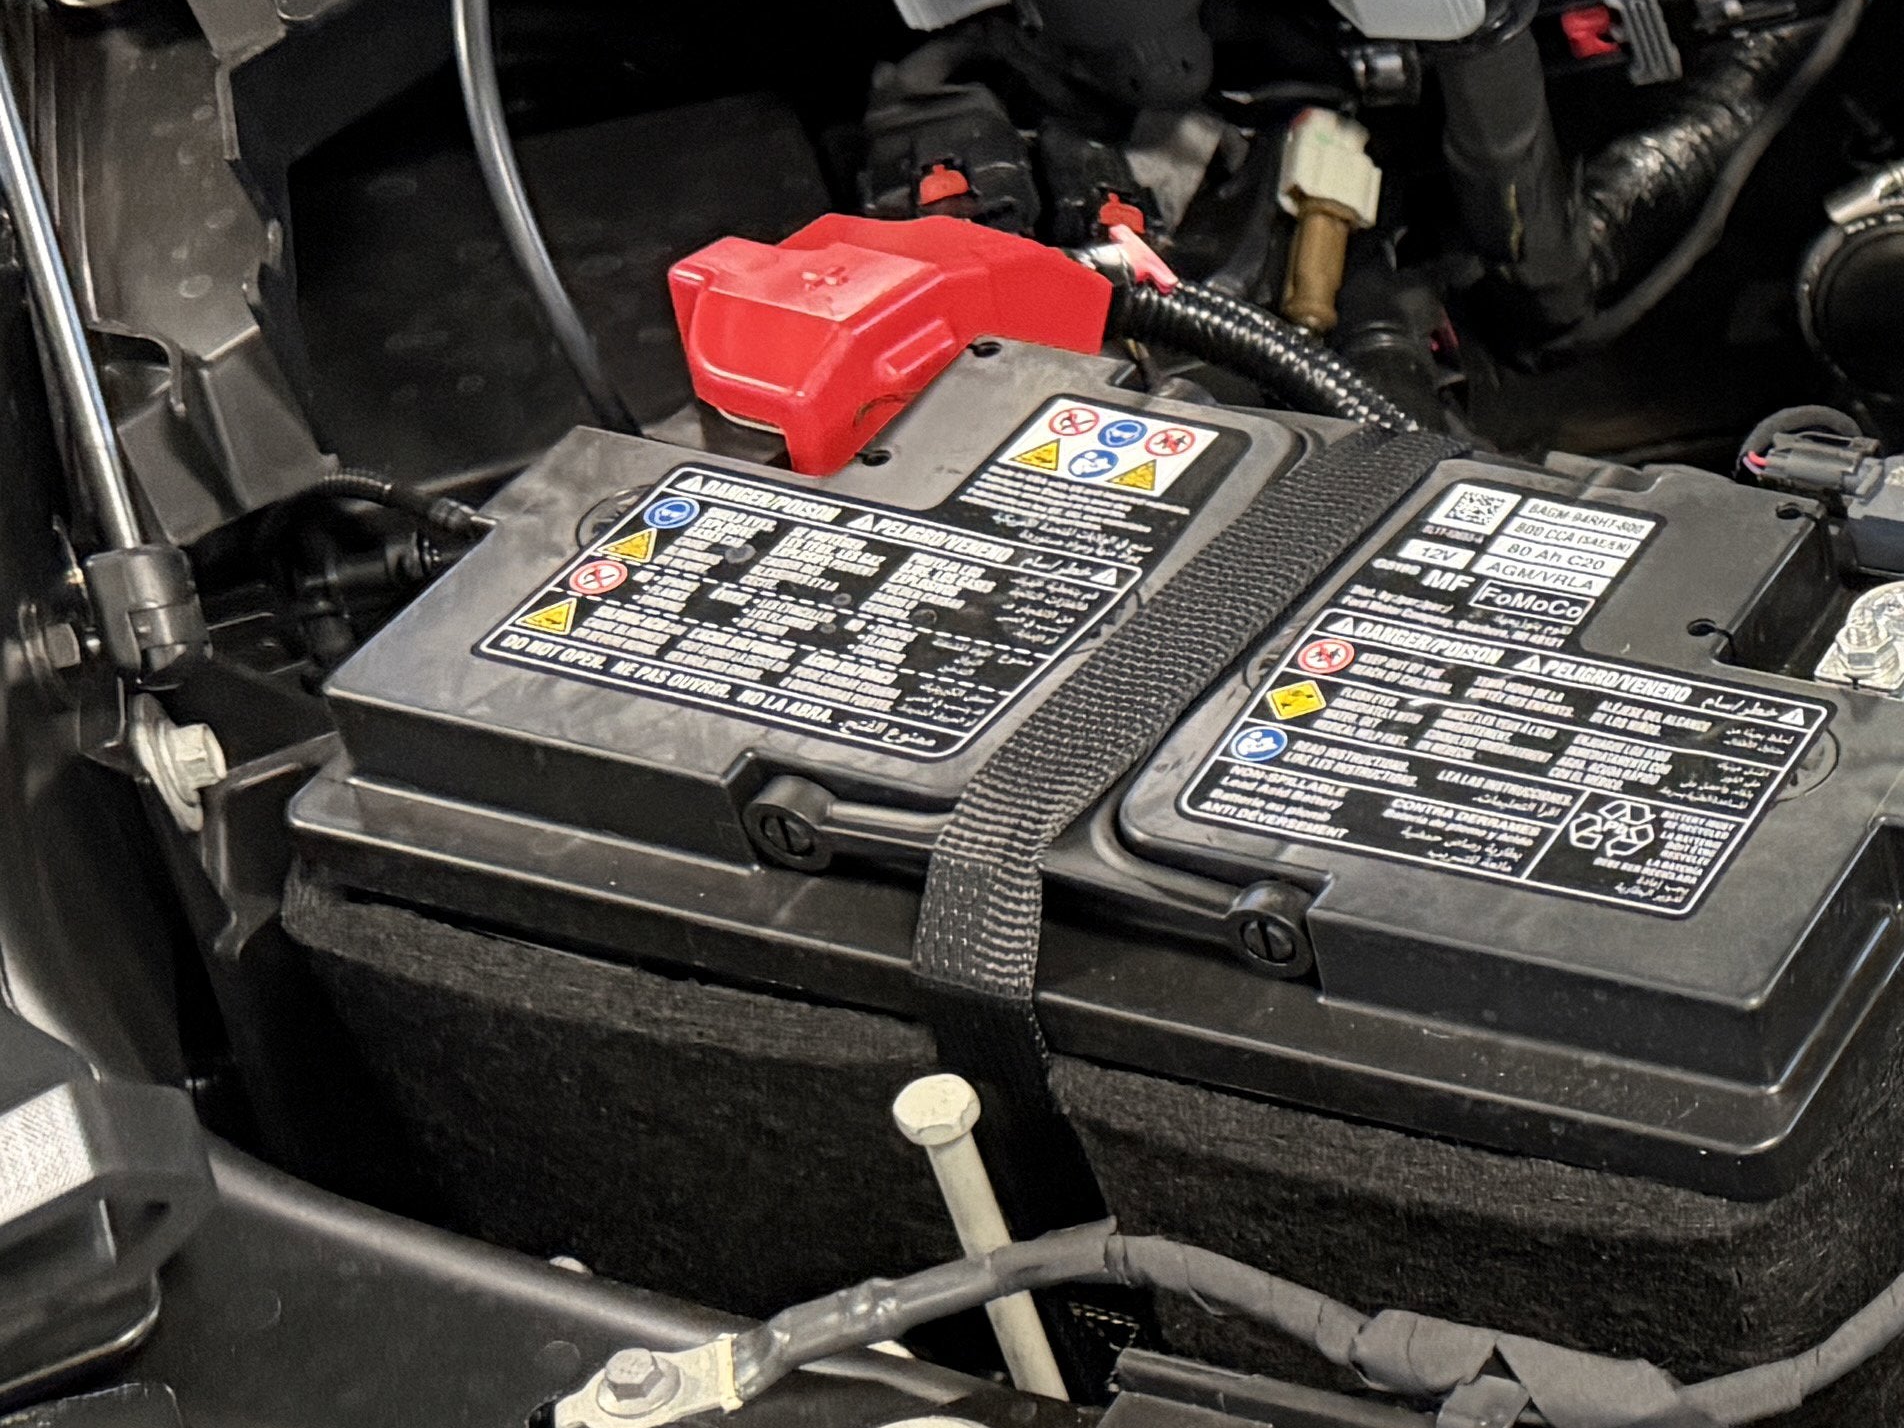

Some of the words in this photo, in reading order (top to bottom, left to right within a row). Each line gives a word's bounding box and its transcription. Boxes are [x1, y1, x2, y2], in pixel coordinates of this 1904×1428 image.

[697, 478, 845, 523] DANGER/POISON
[867, 517, 1019, 563] PELIGRO/VENENO
[1543, 528, 1577, 543] CCA
[1418, 545, 1458, 562] 12V
[1505, 542, 1534, 557] 80
[1534, 548, 1564, 563] Ah
[1564, 555, 1606, 571] C20
[1418, 568, 1477, 594] MF
[1484, 561, 1596, 593] AGM/VRLA
[1475, 584, 1588, 621] FoMoCo
[497, 634, 532, 651] DO
[521, 639, 566, 658] NOT
[608, 660, 642, 676] NE
[631, 665, 674, 683] PAS
[663, 672, 739, 699] OUVRIR.
[733, 689, 769, 705] NO
[760, 695, 793, 711] LA
[783, 700, 843, 723] ABRA.
[1351, 621, 1506, 665] DANGER/POISON
[1538, 659, 1693, 704] PELIGRO/VENENO
[1227, 764, 1350, 797] NON-SPILLABLE
[1197, 798, 1239, 816] ANTI
[1388, 797, 1458, 819] CONTRA
[1453, 810, 1544, 837] DERRAMES
[1599, 819, 1633, 835] Pb
